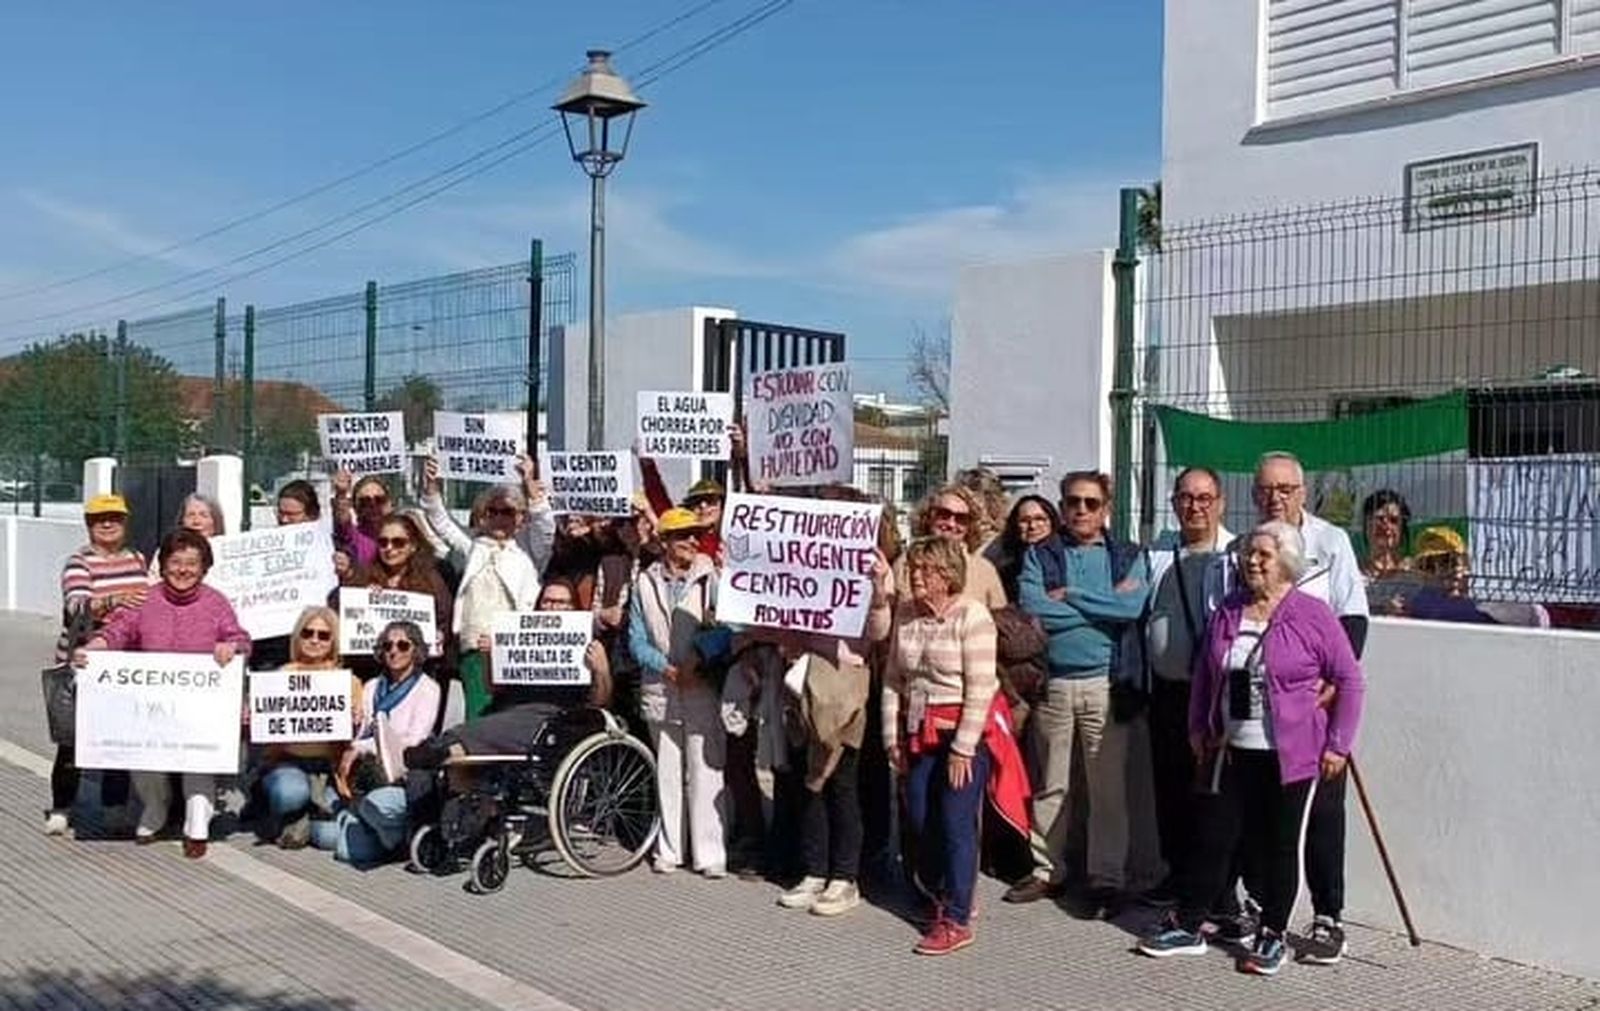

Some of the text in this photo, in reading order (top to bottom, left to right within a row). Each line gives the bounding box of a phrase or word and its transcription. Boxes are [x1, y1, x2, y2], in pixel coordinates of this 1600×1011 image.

[818, 369, 850, 392] CON
[658, 396, 708, 414] EL AGUA
[327, 415, 389, 433] UN CENTRO
[464, 417, 485, 434] SIN
[641, 417, 725, 434] CHORREA POR
[329, 437, 391, 454] EDUCATIVO
[437, 435, 516, 456] LIMPIADORAS
[646, 438, 721, 455] LAS PAREDES
[773, 427, 831, 450] NO CON
[342, 454, 400, 474] CONSERJE
[450, 457, 505, 475] DE TARDE
[551, 455, 617, 472] UN CENTRO
[761, 445, 839, 478] HUMEDAD
[552, 477, 618, 493] EDUCATIVO
[568, 496, 628, 513] CONSERJE
[731, 504, 878, 541] RESTAURACIÓN
[767, 541, 874, 575] URGENTE
[730, 571, 862, 608] CENTRO DE
[369, 592, 409, 607] EDIFICIO
[520, 614, 563, 629] EDIFICIO
[754, 604, 834, 630] ADULTOS
[495, 632, 587, 646] MUY DETERIORADO
[508, 649, 573, 664] POR FALTA DE
[98, 668, 222, 688] ASCENSOR
[288, 674, 311, 692] SIN
[502, 667, 580, 681] MANTENIMIENTO
[255, 695, 346, 713] LIMPIADORAS
[268, 717, 333, 734] DE TARDE
